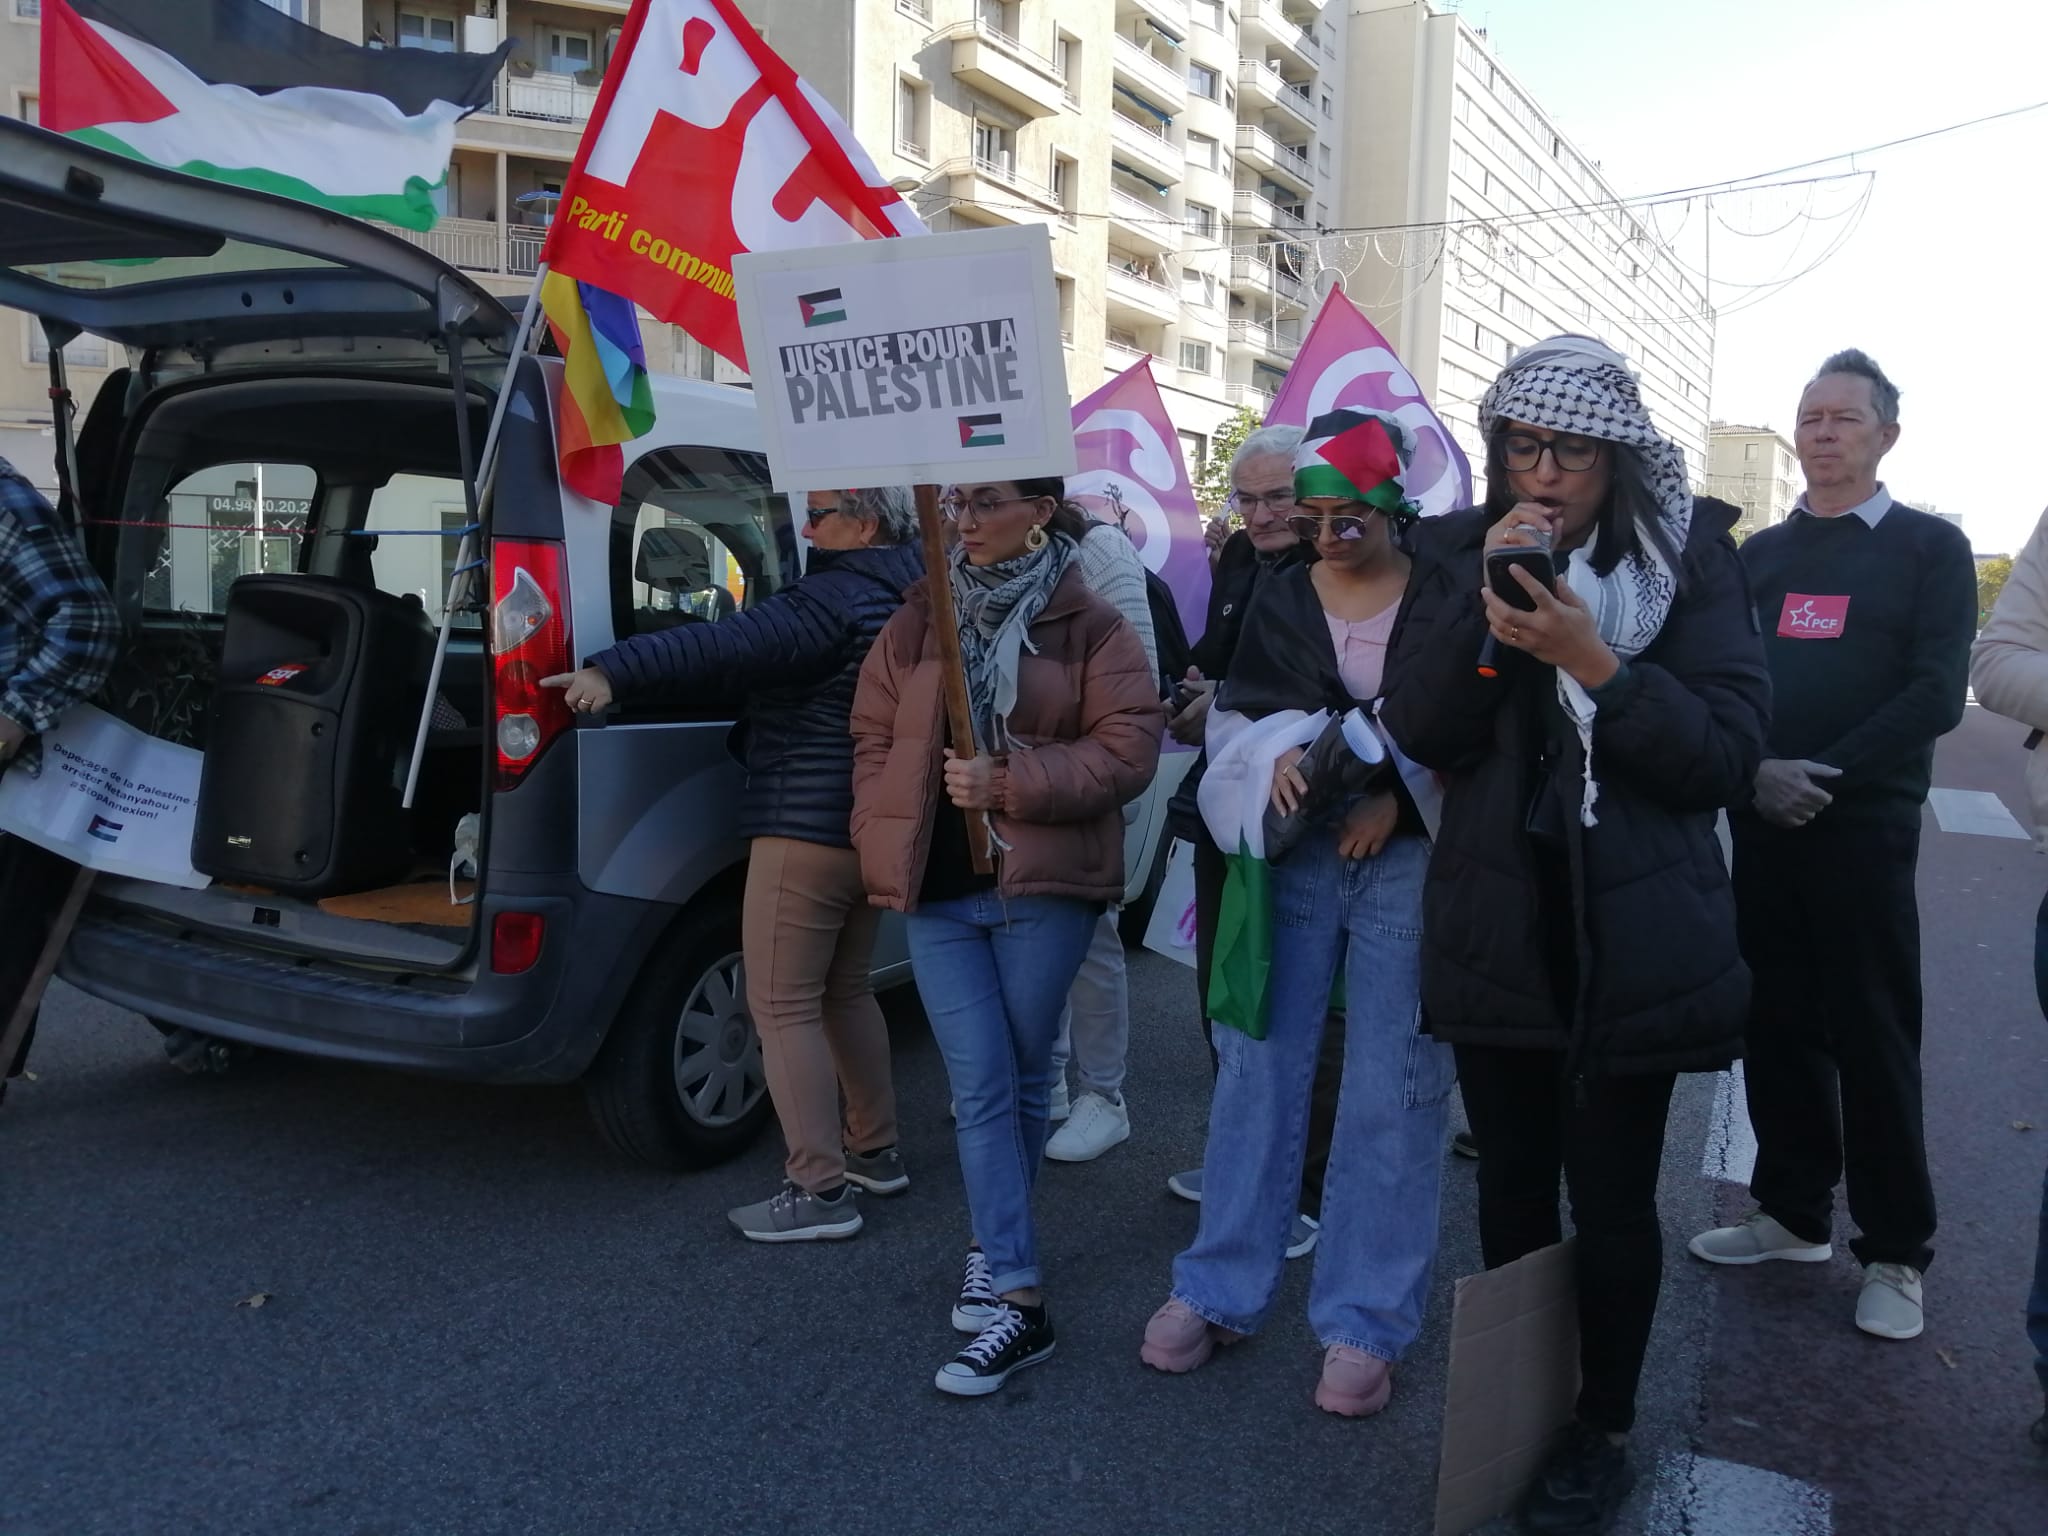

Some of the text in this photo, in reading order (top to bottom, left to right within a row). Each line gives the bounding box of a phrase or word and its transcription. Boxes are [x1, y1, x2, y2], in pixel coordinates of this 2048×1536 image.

[567, 196, 629, 241] Parti
[784, 320, 1017, 378] JUSTICE POUR LA
[786, 351, 1023, 424] PALESTINE
[213, 498, 311, 514] 04.94.0.20.2
[1811, 618, 1838, 629] PCF
[104, 782, 169, 811] Netanyahou
[110, 770, 122, 783] de
[124, 778, 134, 789] la
[137, 783, 190, 805] Palestine
